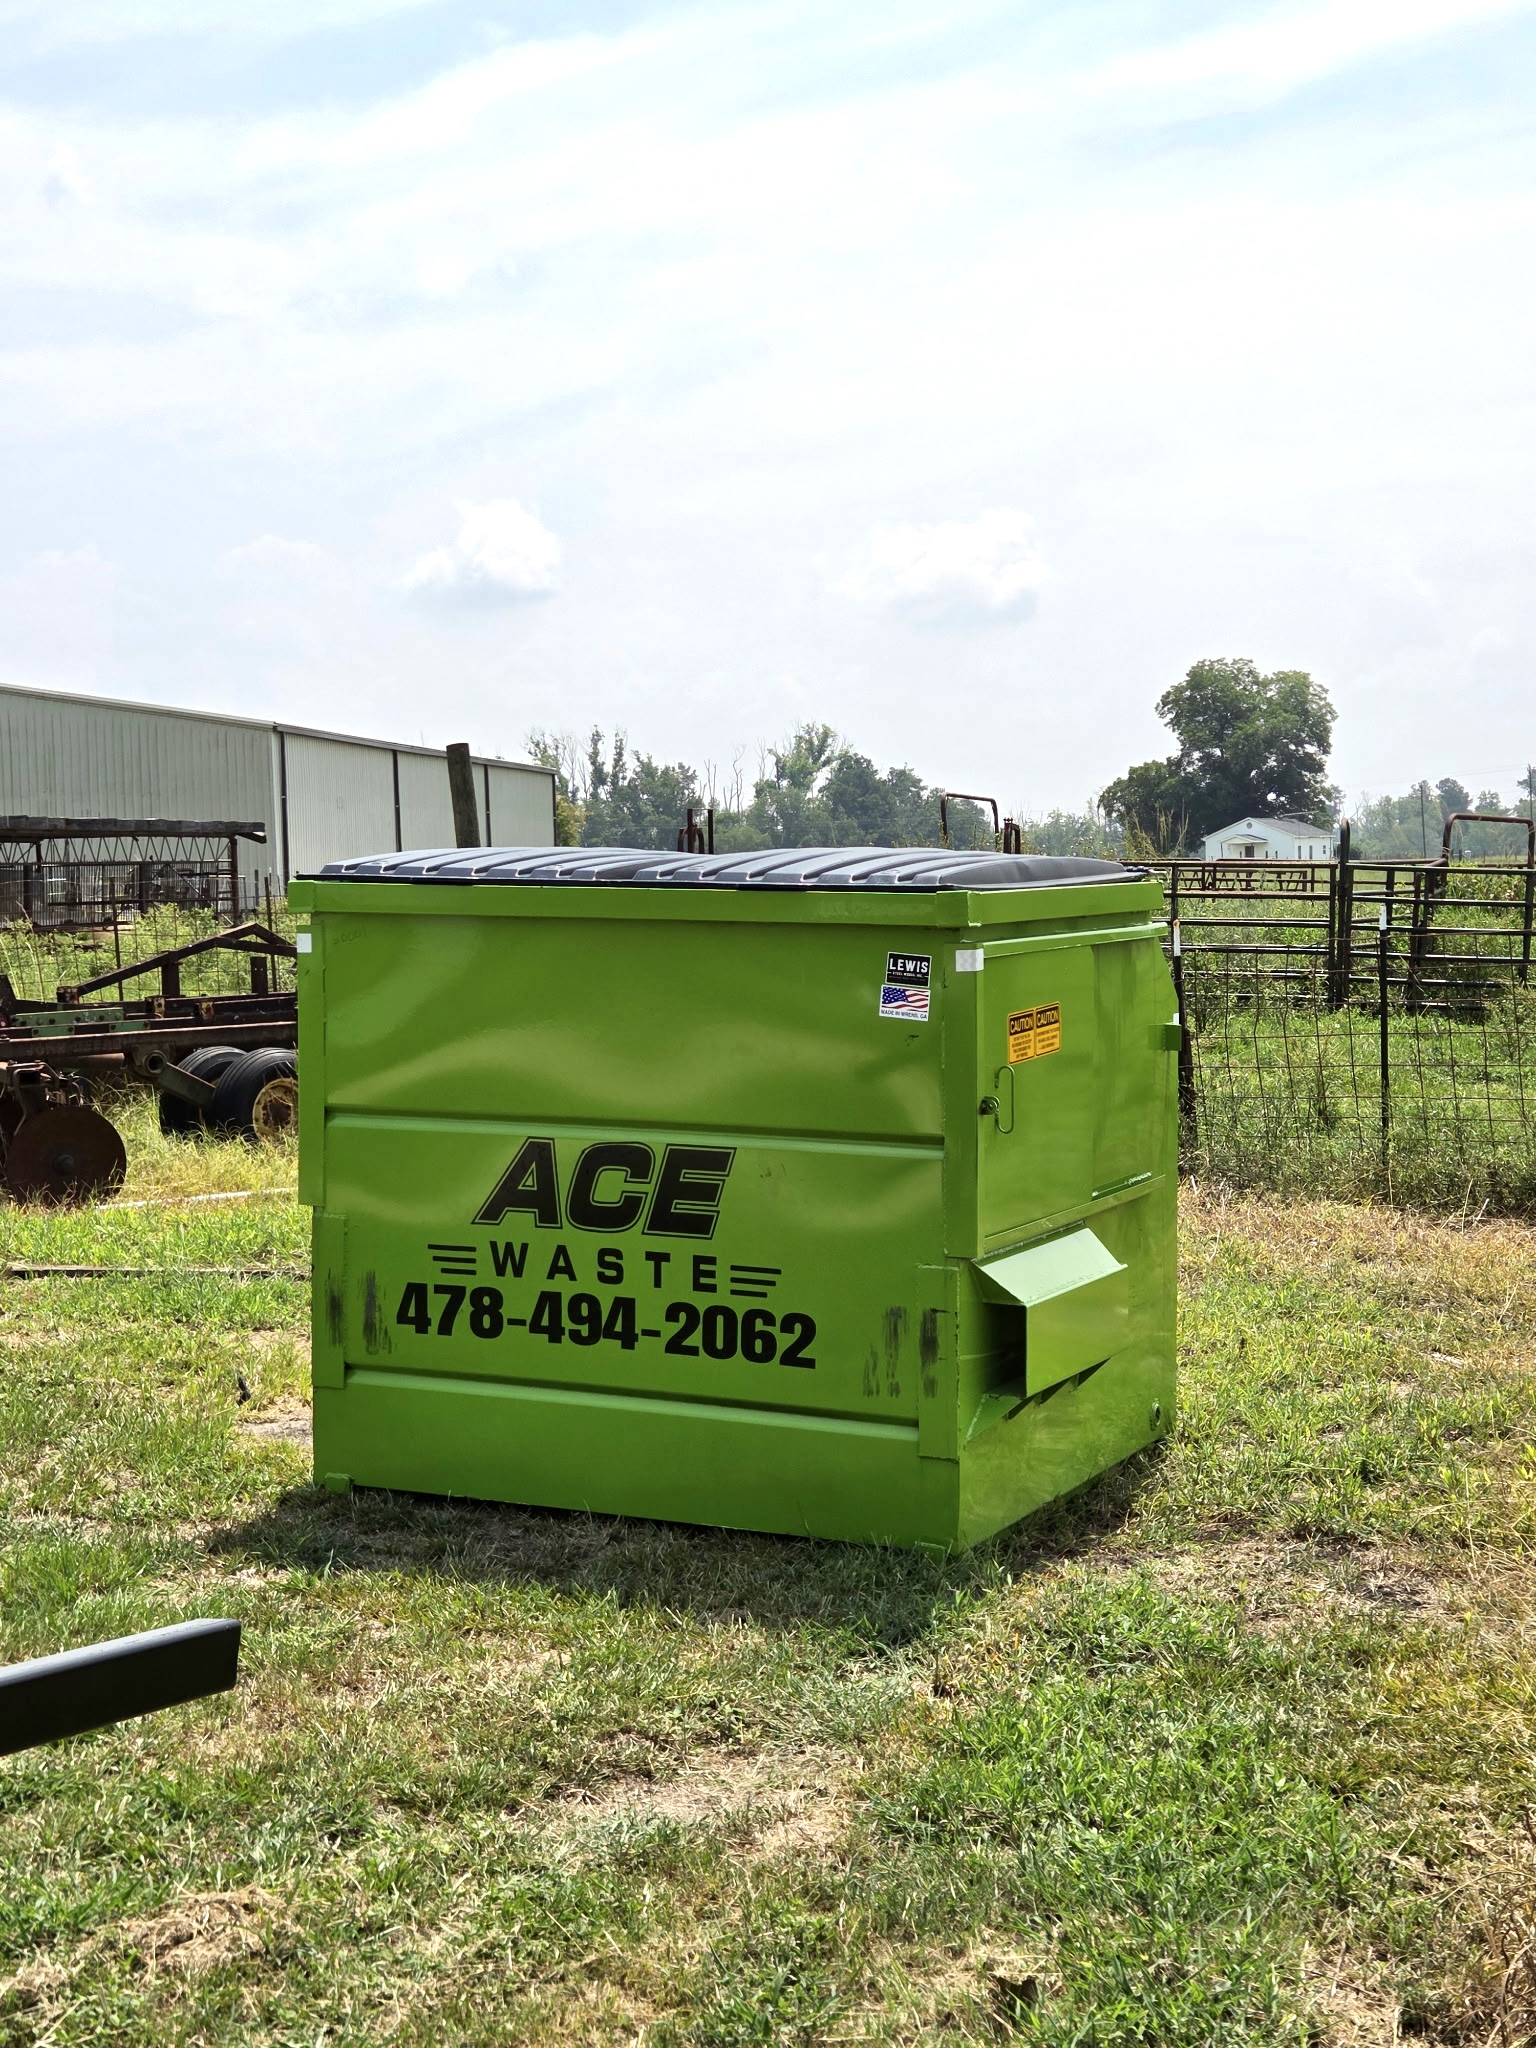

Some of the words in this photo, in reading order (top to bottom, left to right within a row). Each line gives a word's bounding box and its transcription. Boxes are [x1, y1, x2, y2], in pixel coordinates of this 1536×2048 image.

[889, 958, 928, 973] LEWIS
[1010, 1016, 1033, 1034] CAUTION
[1036, 1009, 1059, 1026] CAUTION
[471, 1136, 737, 1240] ACE
[489, 1240, 719, 1293] WASTE
[396, 1282, 817, 1370] 478-494-2062
